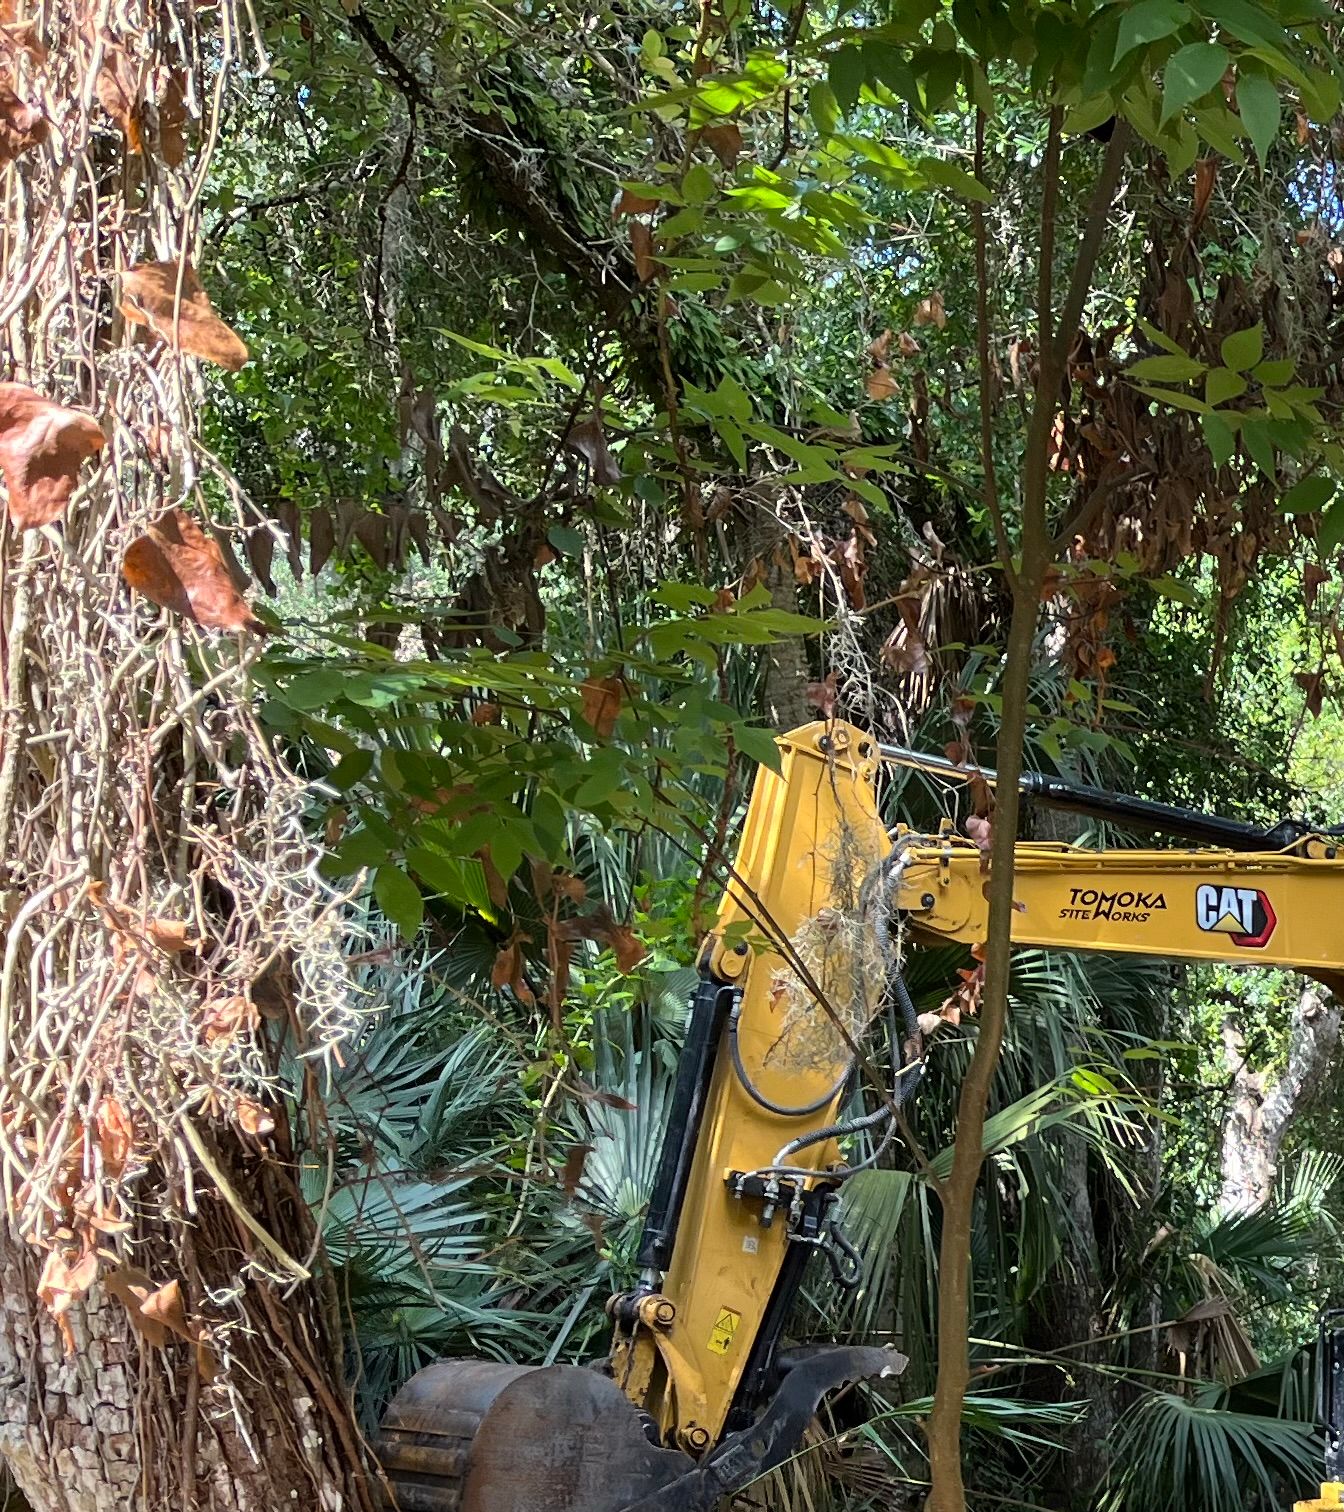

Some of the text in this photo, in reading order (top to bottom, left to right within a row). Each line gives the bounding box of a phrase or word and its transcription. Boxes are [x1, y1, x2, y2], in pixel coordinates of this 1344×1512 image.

[1069, 888, 1168, 910] TOMOKA
[1197, 885, 1258, 935] CAT
[1058, 905, 1151, 923] SITE WORKS
